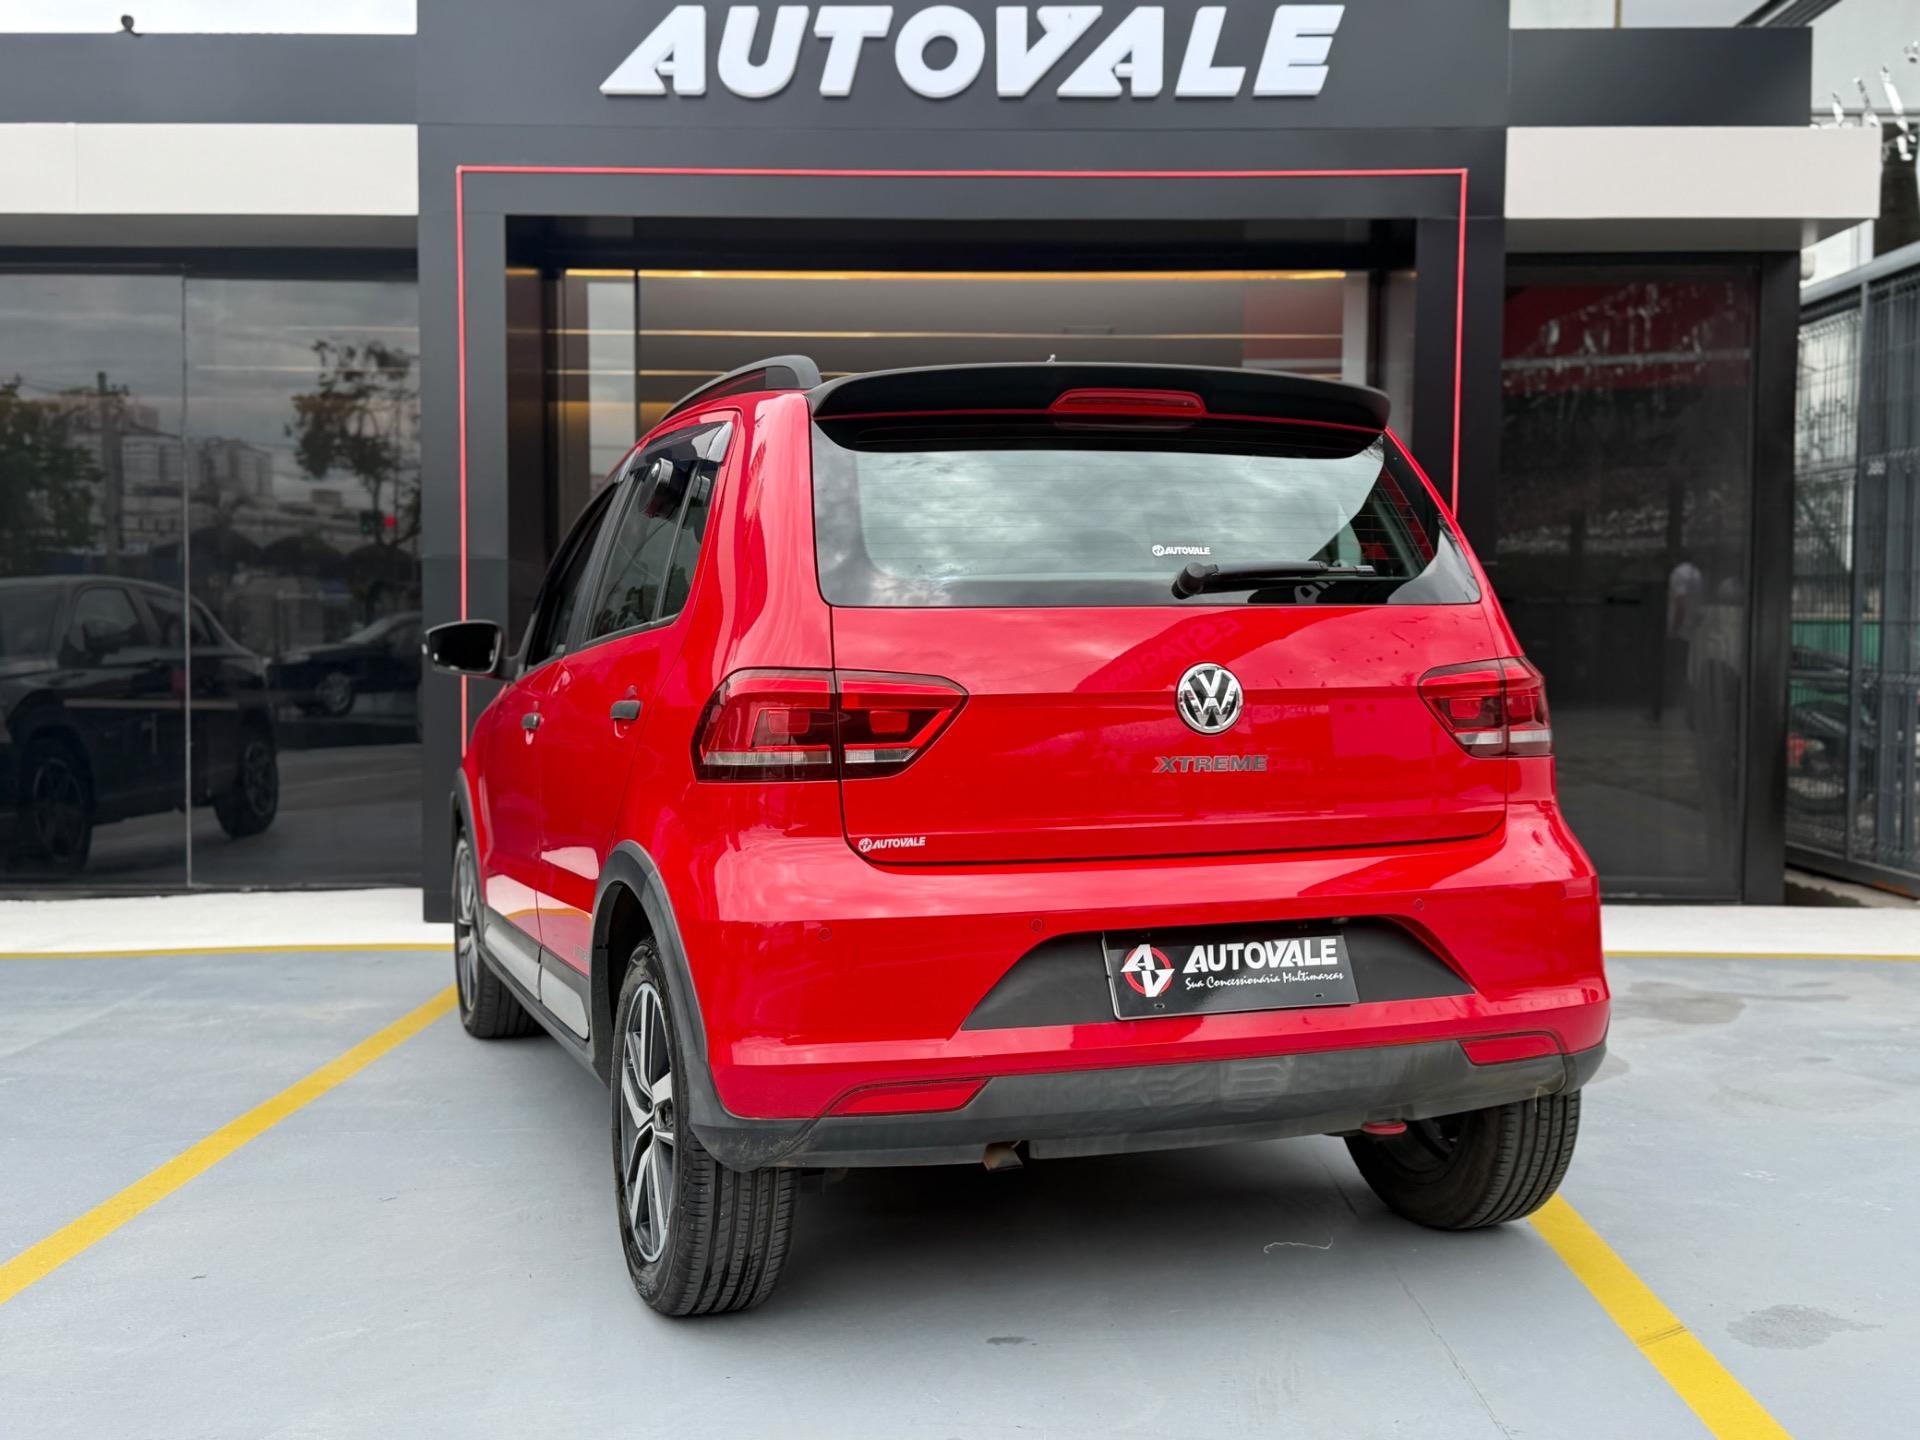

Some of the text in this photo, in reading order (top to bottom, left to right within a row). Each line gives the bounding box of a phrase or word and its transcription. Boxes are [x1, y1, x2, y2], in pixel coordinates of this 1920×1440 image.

[600, 4, 1345, 98] AUTOVALE
[1164, 546, 1211, 555] AUTOVALE
[1152, 755, 1268, 773] XTREME
[872, 836, 927, 850] AUTOVALE
[1182, 938, 1338, 974] AUTOVALE
[1185, 977, 1204, 990] Sua
[1283, 969, 1344, 984] Multimarcas
